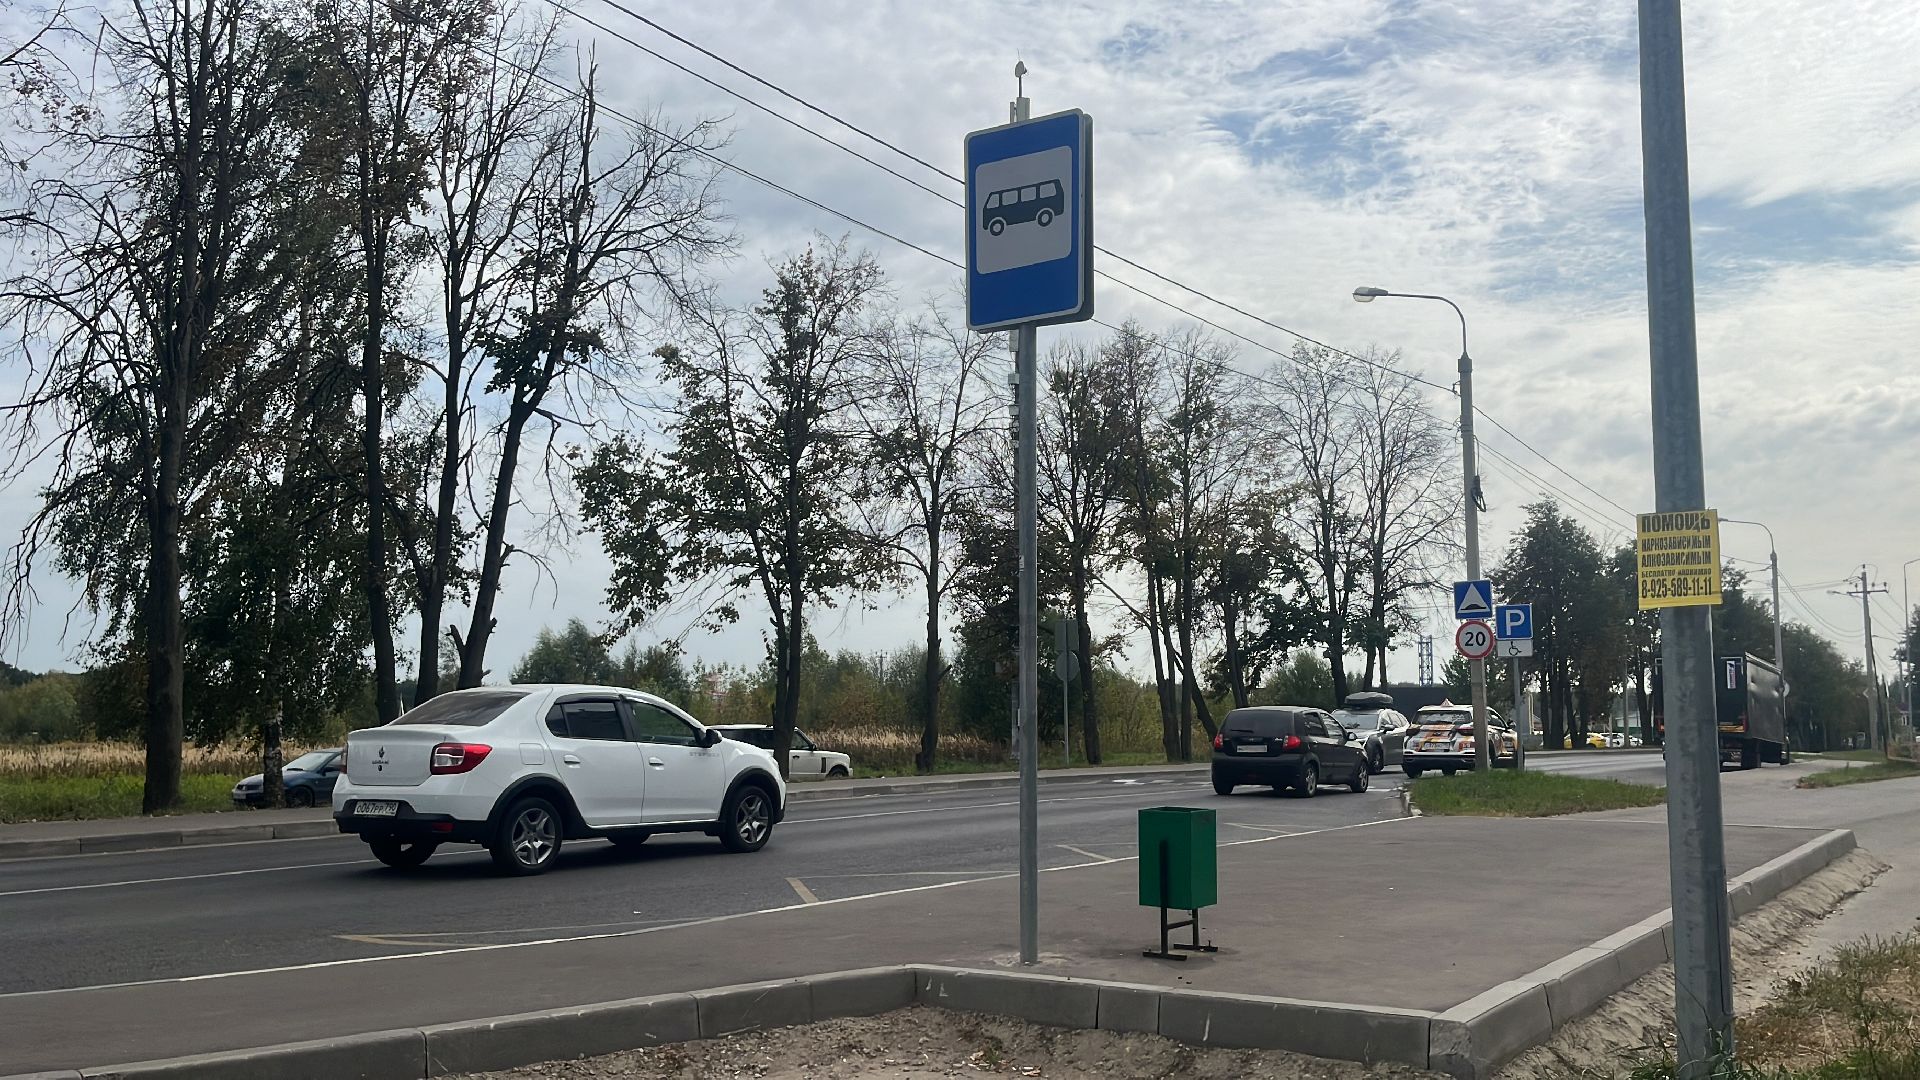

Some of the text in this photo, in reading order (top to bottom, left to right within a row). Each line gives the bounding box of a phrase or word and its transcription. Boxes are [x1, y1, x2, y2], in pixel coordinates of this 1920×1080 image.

[1641, 513, 1711, 532] ПОМОЩЬ
[1641, 535, 1711, 552] НАРКОЗАВИСИМЫМ
[1641, 551, 1712, 567] АЛКОЗАВИСИМЫМ
[1641, 569, 1676, 578] БЕСПЛАТНО
[1641, 577, 1712, 598] 8-925-589-11-11
[1464, 631, 1486, 647] 20
